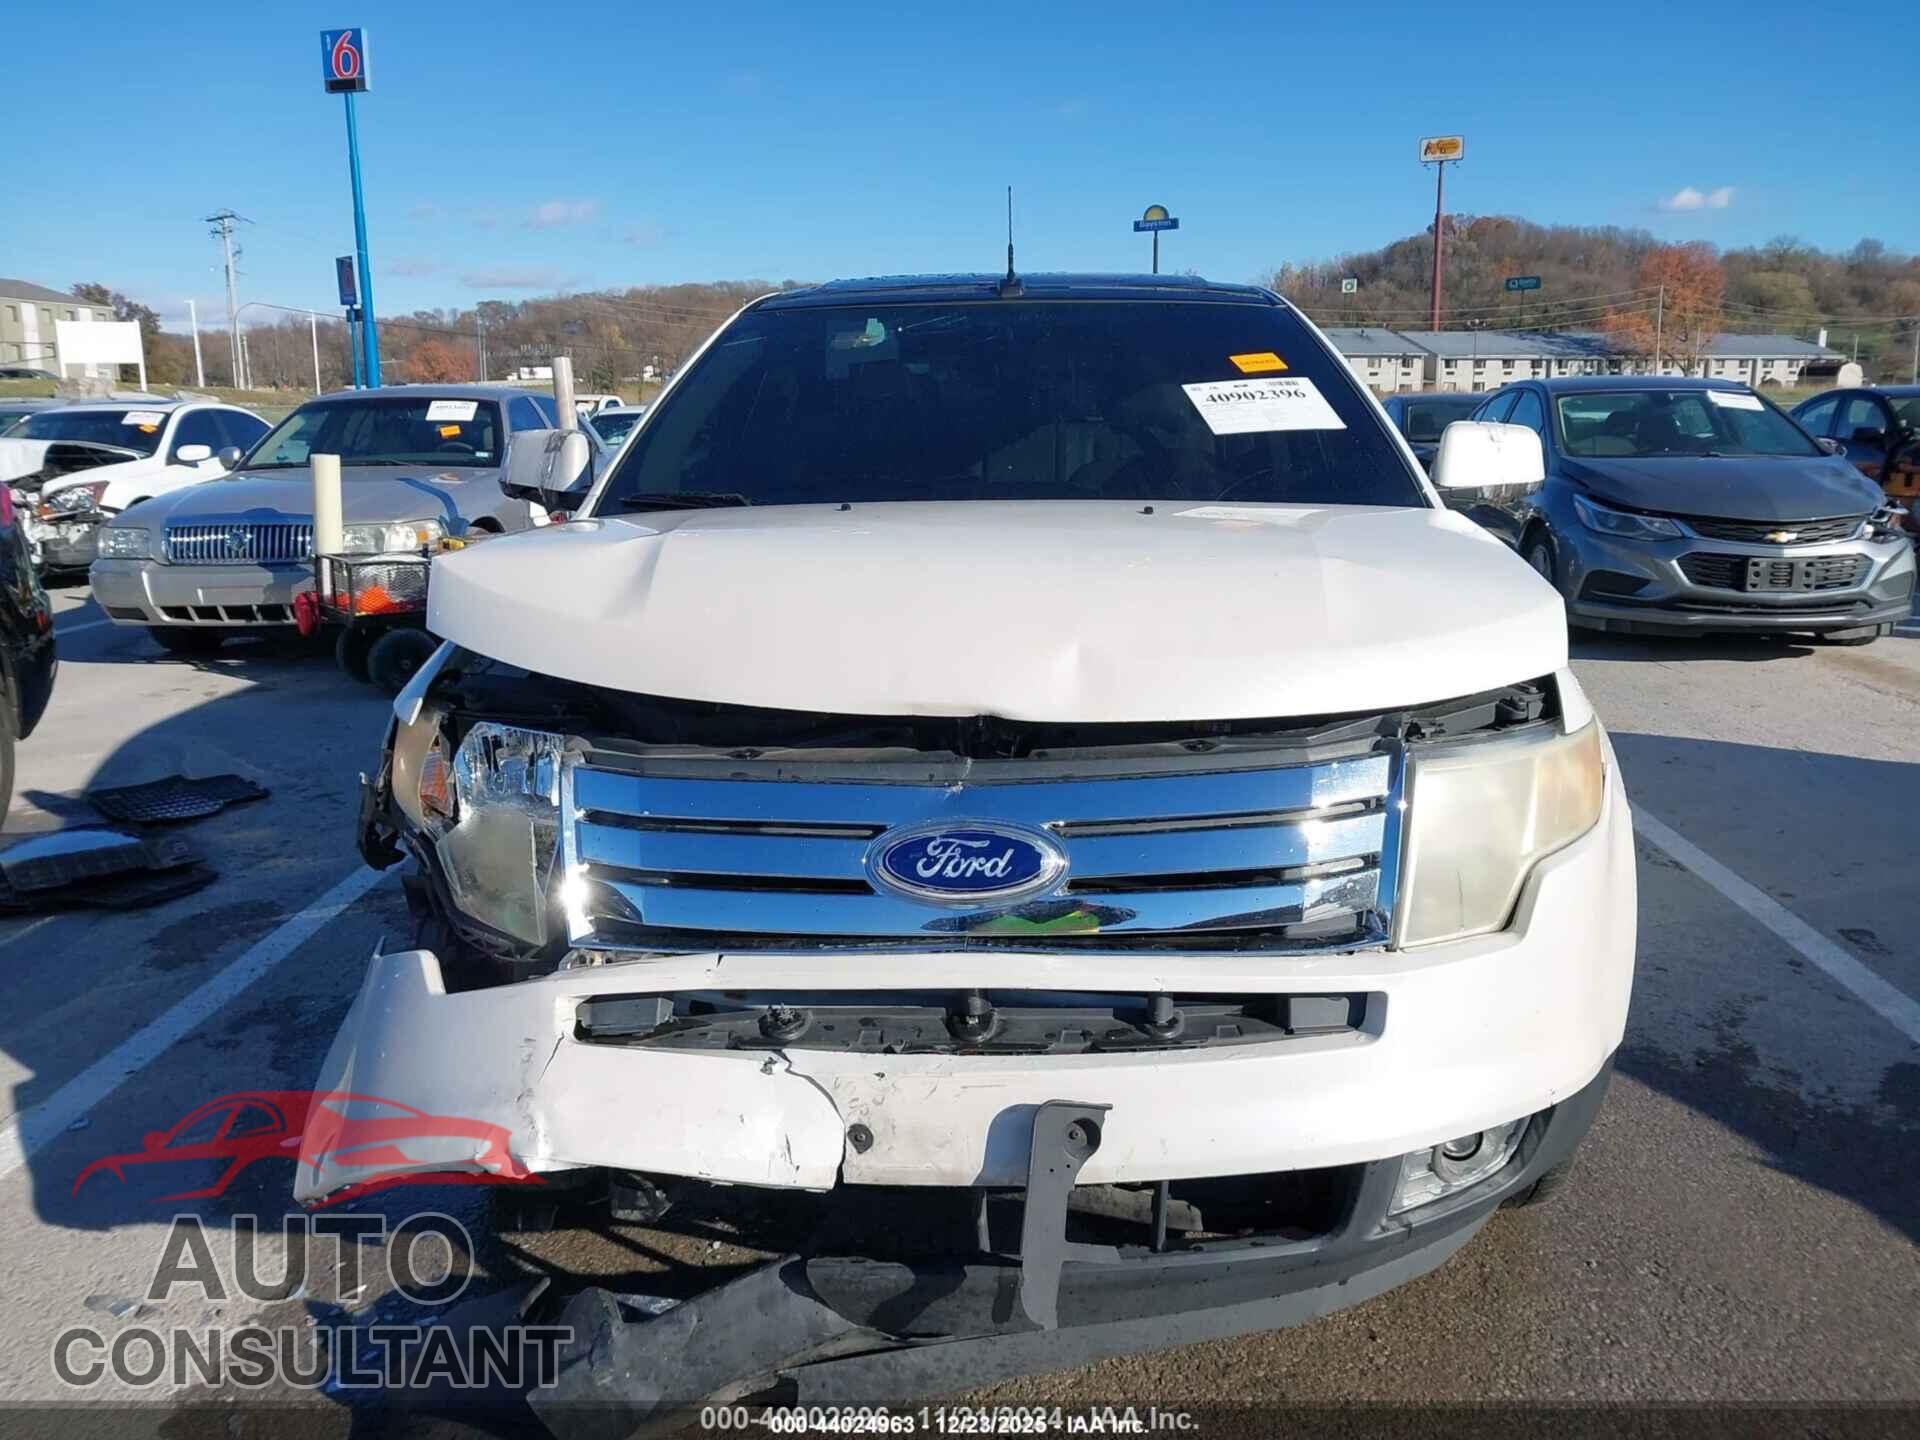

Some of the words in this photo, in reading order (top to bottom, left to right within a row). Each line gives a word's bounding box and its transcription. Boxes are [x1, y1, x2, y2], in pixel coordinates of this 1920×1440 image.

[333, 31, 360, 79] 6
[1206, 388, 1307, 404] 40902396
[916, 836, 1014, 878] Ford
